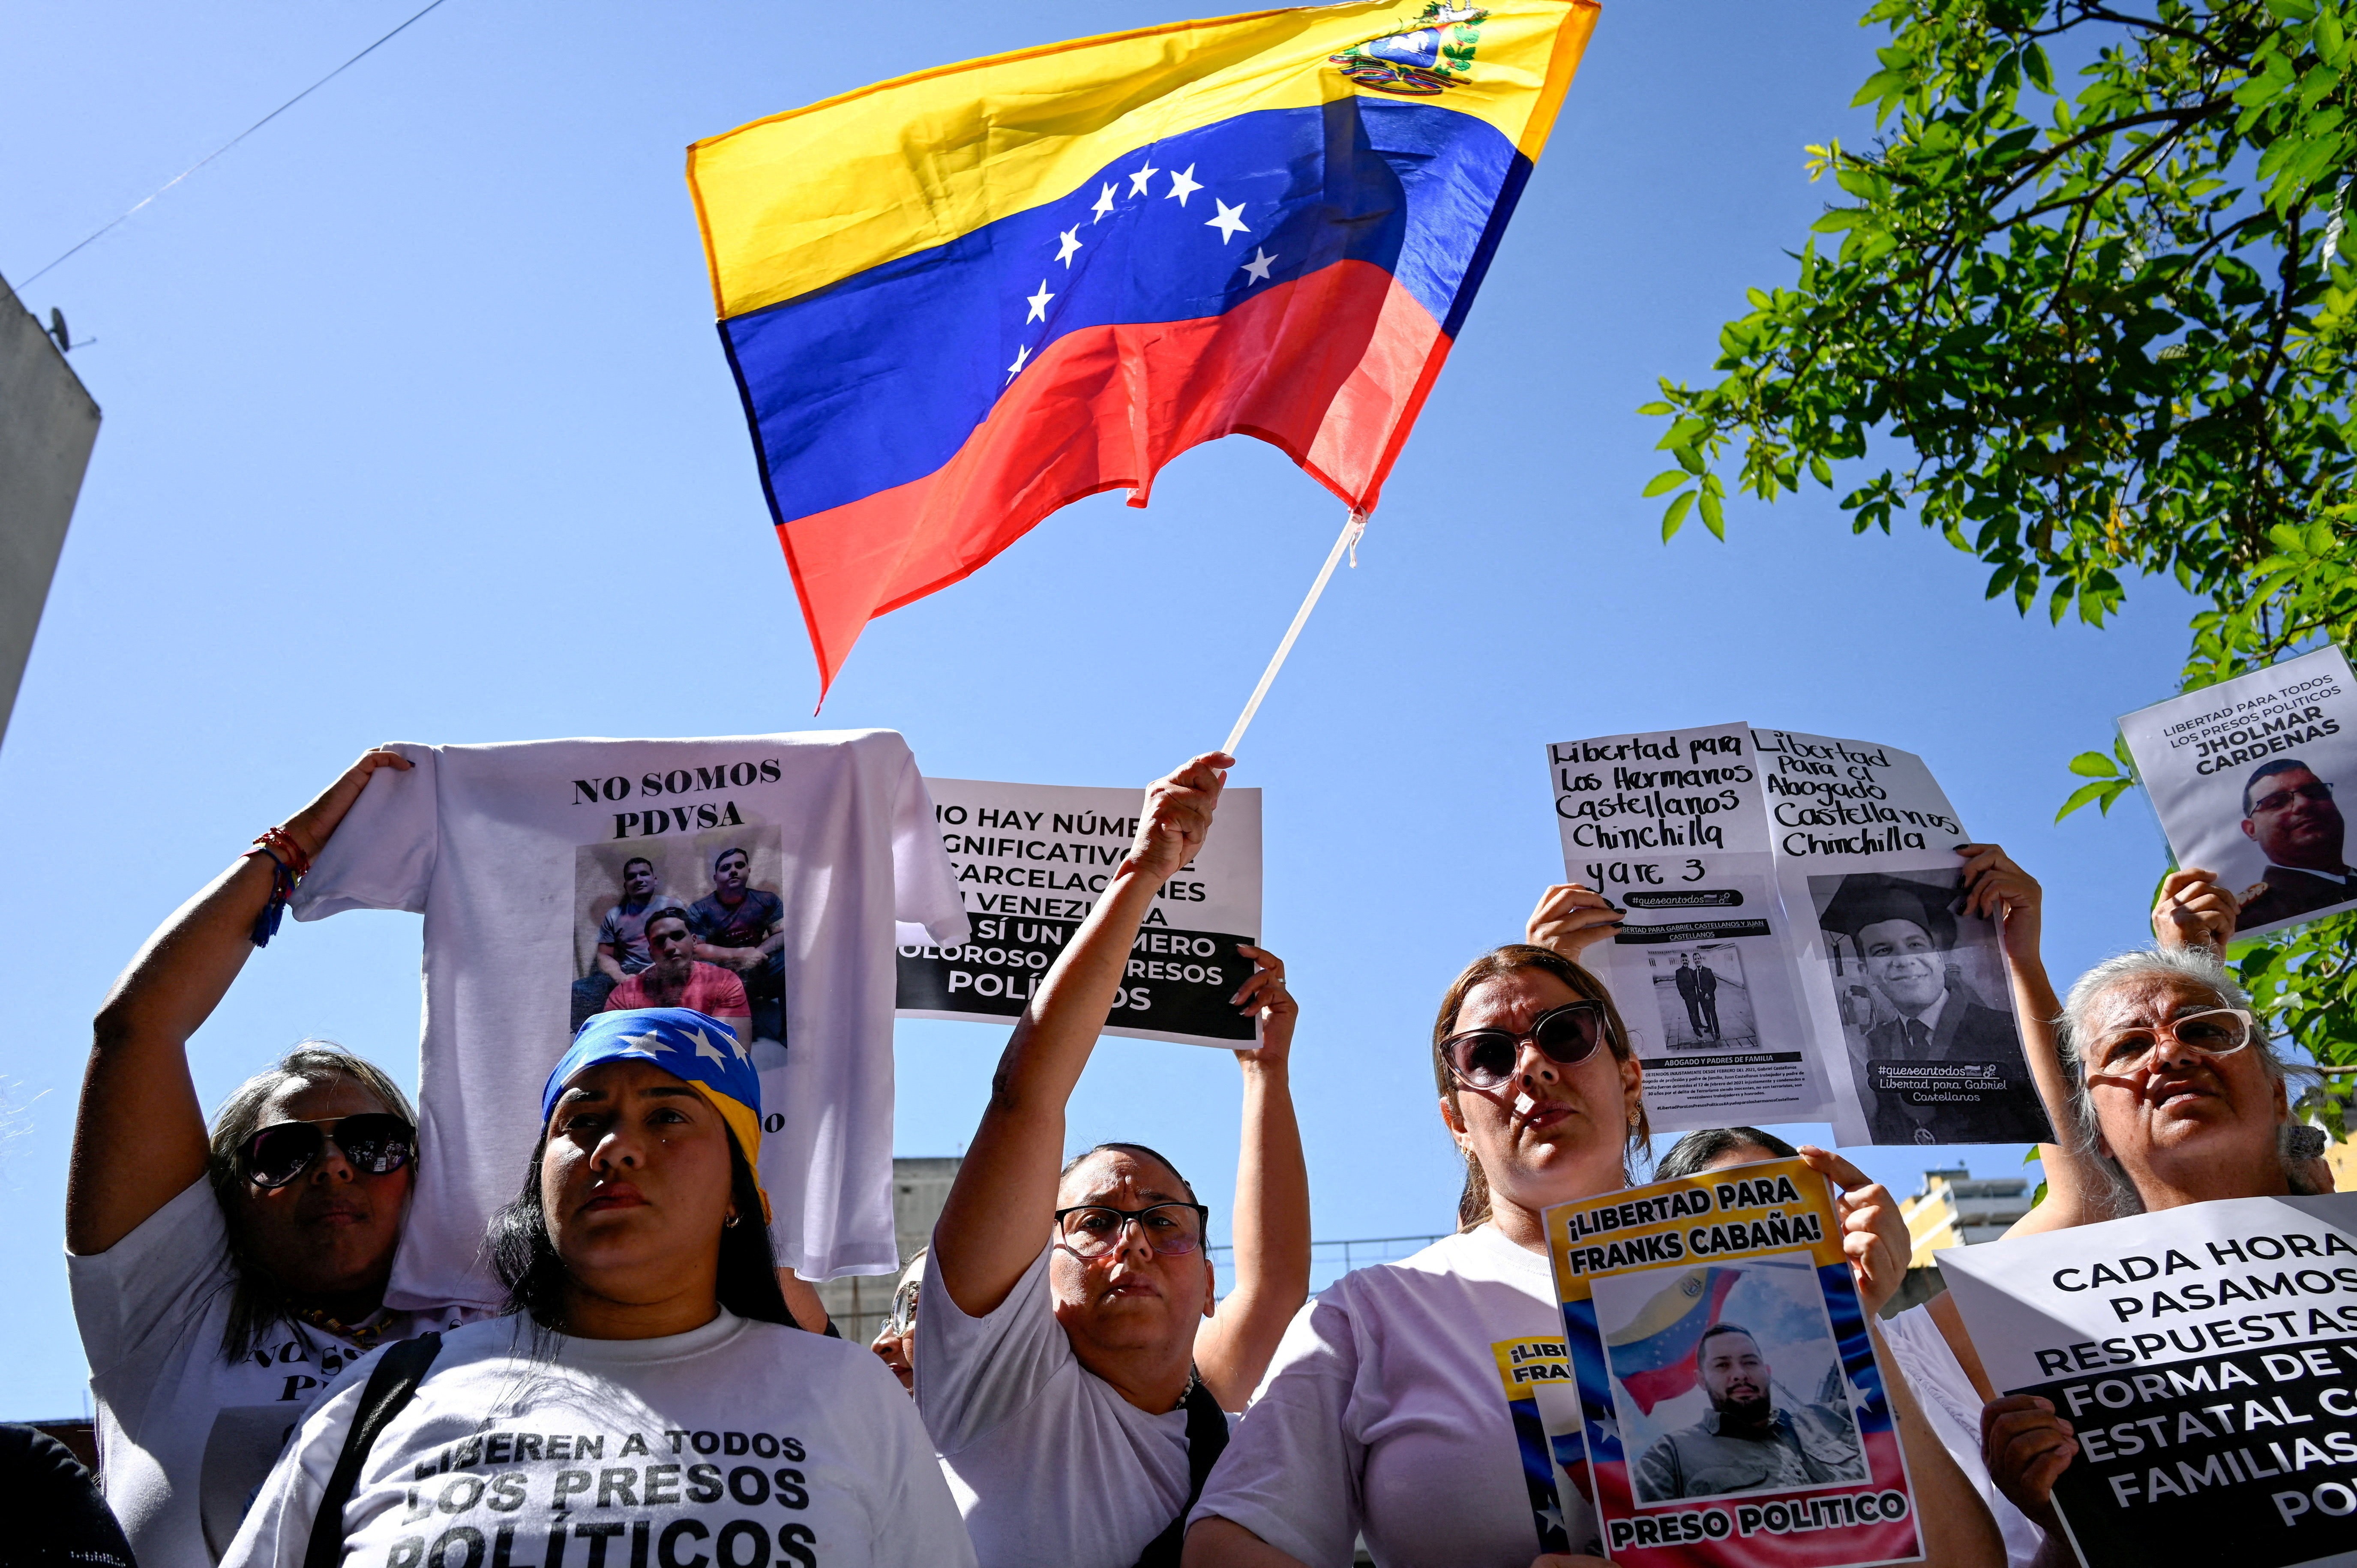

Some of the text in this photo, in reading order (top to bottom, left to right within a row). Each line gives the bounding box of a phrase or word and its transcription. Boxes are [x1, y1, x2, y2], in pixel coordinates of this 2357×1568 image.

[2163, 675, 2333, 737] LIBERTAD PARA TODOS
[2170, 686, 2341, 749] LOS PRESOS POLITICOS
[1552, 736, 1742, 765] Libertad para
[1750, 730, 1891, 767] Libertad
[2195, 706, 2324, 758] JHOLMAR
[2196, 719, 2340, 775] CARDENAS
[572, 758, 781, 805] NO SOMOS
[1614, 765, 1753, 791] Hermanos
[1768, 774, 1886, 806] Abogado
[1847, 766, 1874, 782] el
[612, 801, 744, 839] PDVSA
[978, 808, 1044, 831] HAY
[1556, 789, 1740, 821] Castellanos
[1774, 800, 1959, 834] Castellanos
[1573, 815, 1723, 850] Chinchilla
[1782, 826, 1925, 857] Chinchilla
[1682, 859, 1706, 882] 3
[1632, 895, 1704, 905] #queseantodos
[978, 917, 1009, 940] SÍ
[1017, 923, 1062, 945] UN
[1670, 932, 1715, 940] CASTELLANOS
[899, 945, 1223, 986] OLOROSO RESOS
[1745, 1055, 1773, 1063] FAMILIA
[1878, 1065, 1965, 1076] #queseantodos
[1880, 1079, 2007, 1091] Libertad para Gabriel
[1913, 1092, 1980, 1101] Castellanos
[1569, 1177, 1799, 1241] ¡LIBERTAD PARA
[1570, 1211, 1822, 1274] FRANKS CABAÑA!
[2053, 1233, 2357, 1292] CADA HORA
[2109, 1268, 2357, 1323] PASAMOS
[2034, 1305, 2357, 1377] RESPUESTAS
[2062, 1347, 2342, 1417] FORMA DE
[619, 1433, 649, 1457] A
[664, 1430, 806, 1462] TODOS
[2078, 1396, 2314, 1463] ESTATAL
[2108, 1432, 2357, 1508] FAMILIAS
[402, 1463, 809, 1526] LOS PRESOS
[1611, 1493, 1907, 1548] PRESO POLITICO
[387, 1511, 816, 1568] POLÍTICOS
